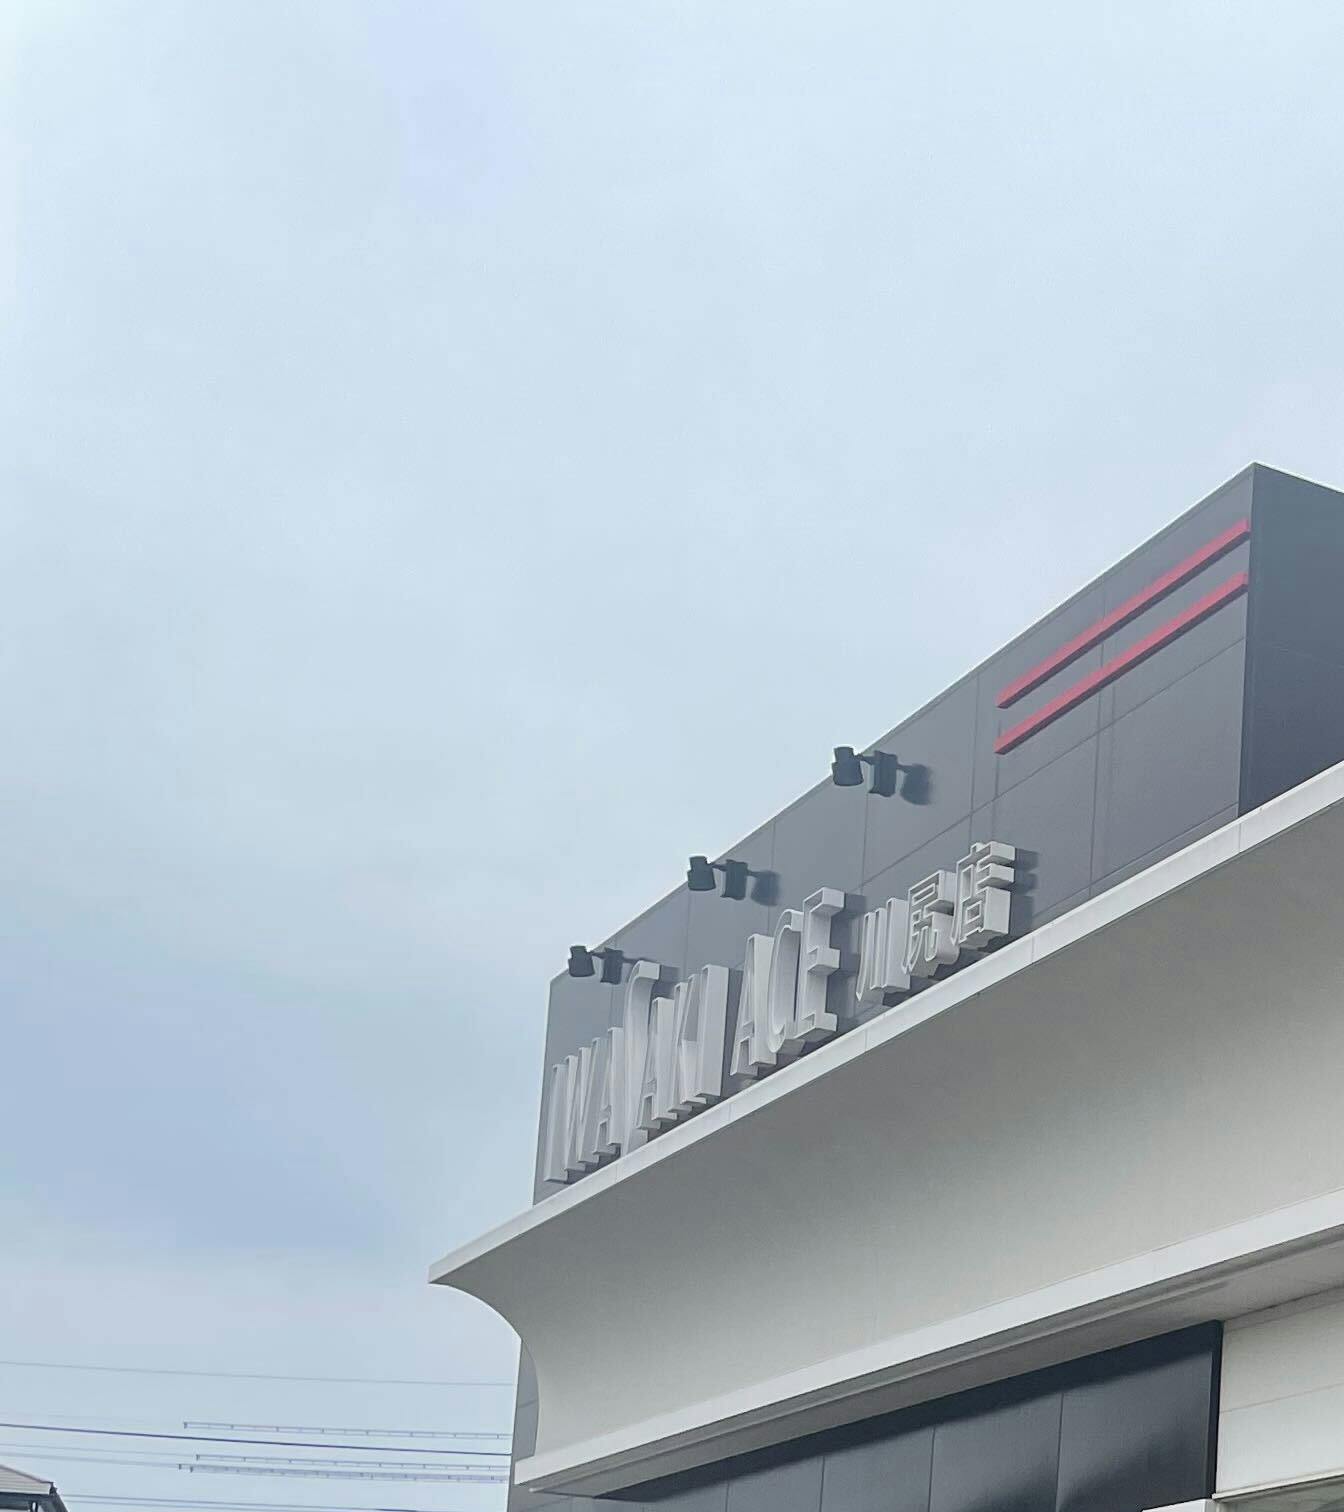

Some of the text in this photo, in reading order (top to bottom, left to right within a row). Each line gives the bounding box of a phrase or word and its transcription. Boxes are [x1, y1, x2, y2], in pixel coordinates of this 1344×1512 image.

[856, 841, 1016, 1001] 川尻店
[544, 887, 846, 1184] IWASAKI ACE
